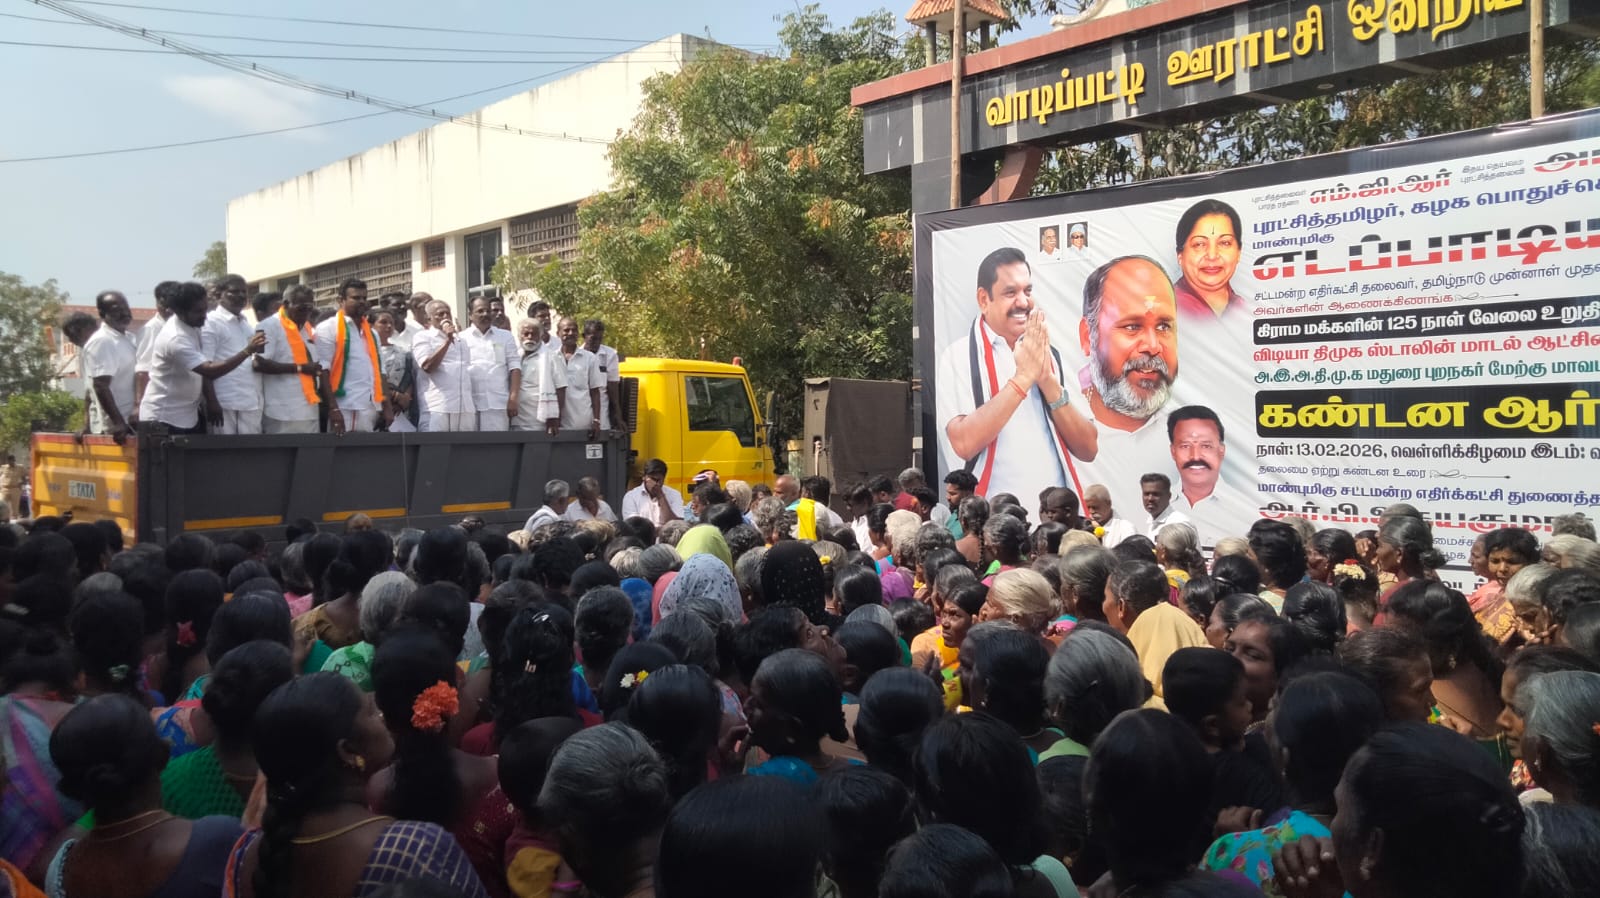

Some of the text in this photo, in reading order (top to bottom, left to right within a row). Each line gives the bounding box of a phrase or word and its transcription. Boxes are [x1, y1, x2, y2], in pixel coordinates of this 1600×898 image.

[985, 62, 1145, 126] வாடிப்பட்டி
[1167, 4, 1325, 86] ஊராட்சி
[1254, 203, 1405, 235] புரட்சித்தமிழர்,
[1411, 196, 1470, 216] கழக
[1252, 233, 1334, 250] மாண்புமிகு
[1255, 288, 1306, 301] சட்டமன்ற
[1421, 271, 1486, 291] தமிழ்நாடு
[1489, 264, 1561, 285] முன்னாள்
[1253, 302, 1325, 316] அவர்களின்
[1257, 323, 1301, 339] கிராம
[1304, 316, 1384, 336] மக்களின்
[1388, 315, 1417, 330] 125
[1421, 311, 1465, 333] நாள்
[1468, 308, 1537, 326] வேலை
[1253, 330, 1600, 364] விடியா திமுக ஸ்டாலின் மாடல் ஆட்சி
[1367, 366, 1421, 384] மதுரை
[1425, 362, 1484, 382] புறநகர்
[1488, 359, 1547, 379] மேற்கு
[1258, 395, 1470, 428] கண்டன
[1391, 443, 1526, 463] வெள்ளிக்கிழமை
[1531, 442, 1585, 459] இடம்:
[1257, 465, 1309, 475] தலைமை
[1343, 465, 1389, 476] கண்டன
[1392, 468, 1426, 478] உரை
[76, 483, 96, 498] TATA
[1257, 482, 1337, 498] மாண்புமிகு
[1340, 485, 1412, 500] சட்டமன்ற
[1416, 487, 1503, 502] எதிர்க்கட்சி
